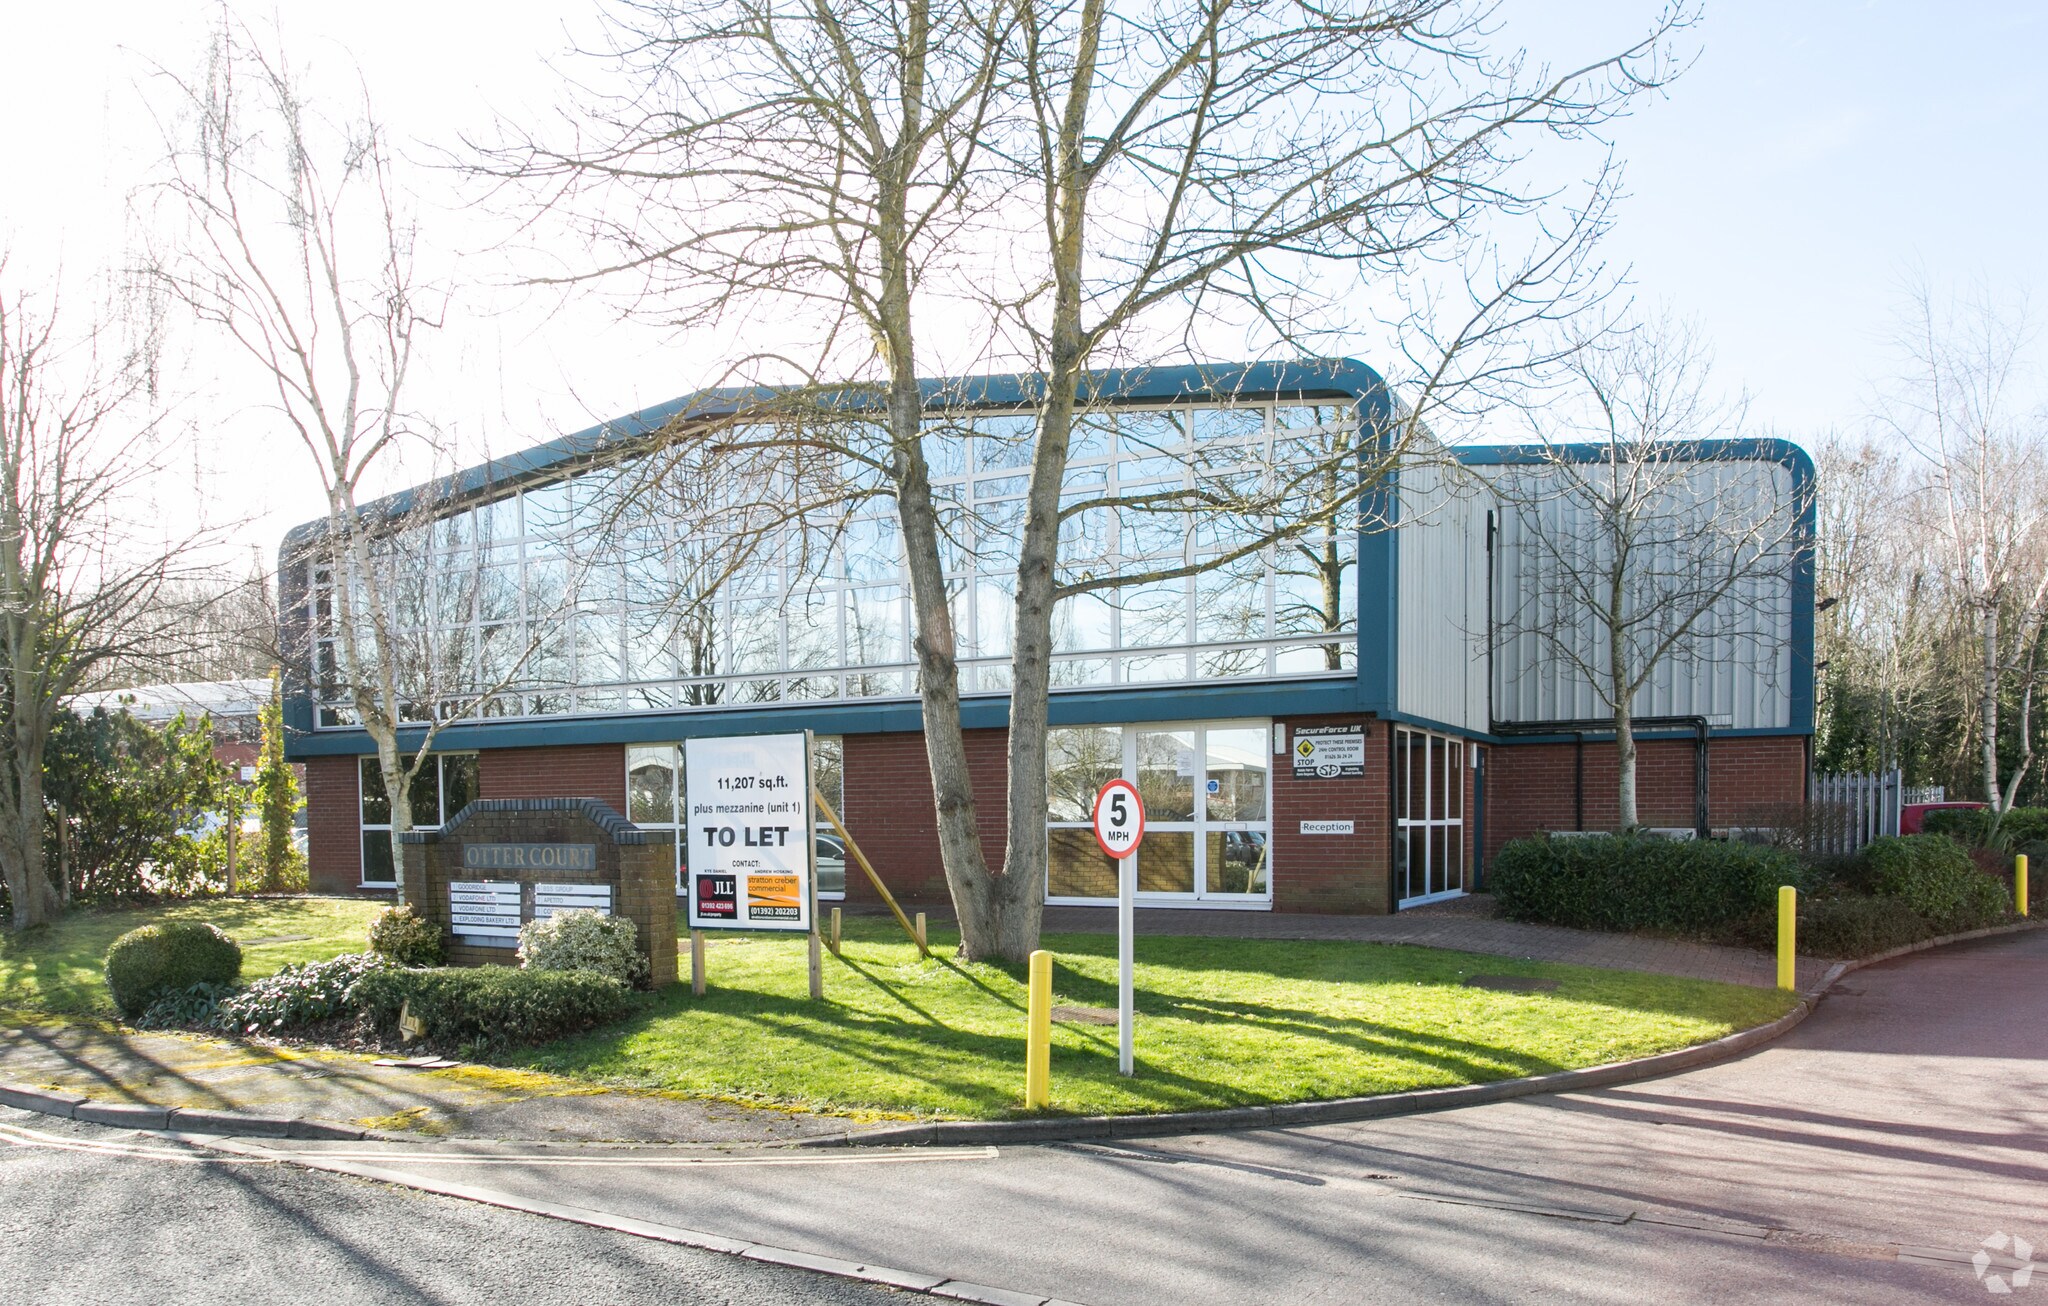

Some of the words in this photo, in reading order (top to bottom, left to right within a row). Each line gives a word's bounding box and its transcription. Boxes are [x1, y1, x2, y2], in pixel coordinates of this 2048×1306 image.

[1296, 726, 1348, 734] SecureForce
[718, 777, 754, 791] 11,207
[759, 776, 788, 790] sq.ft.
[694, 803, 713, 816] plus
[716, 802, 764, 813] mezzanine
[767, 802, 789, 815] (unit
[792, 802, 800, 815] 1)
[1110, 794, 1127, 826] 5
[1304, 823, 1350, 832] Reception
[704, 827, 736, 847] TO
[745, 827, 789, 846] LET
[1108, 831, 1129, 841] MPH
[467, 847, 525, 865] OTTER
[529, 847, 592, 866] COURT
[732, 860, 760, 868] CONTACT:
[714, 881, 733, 895] JLL
[748, 884, 786, 892] commercial
